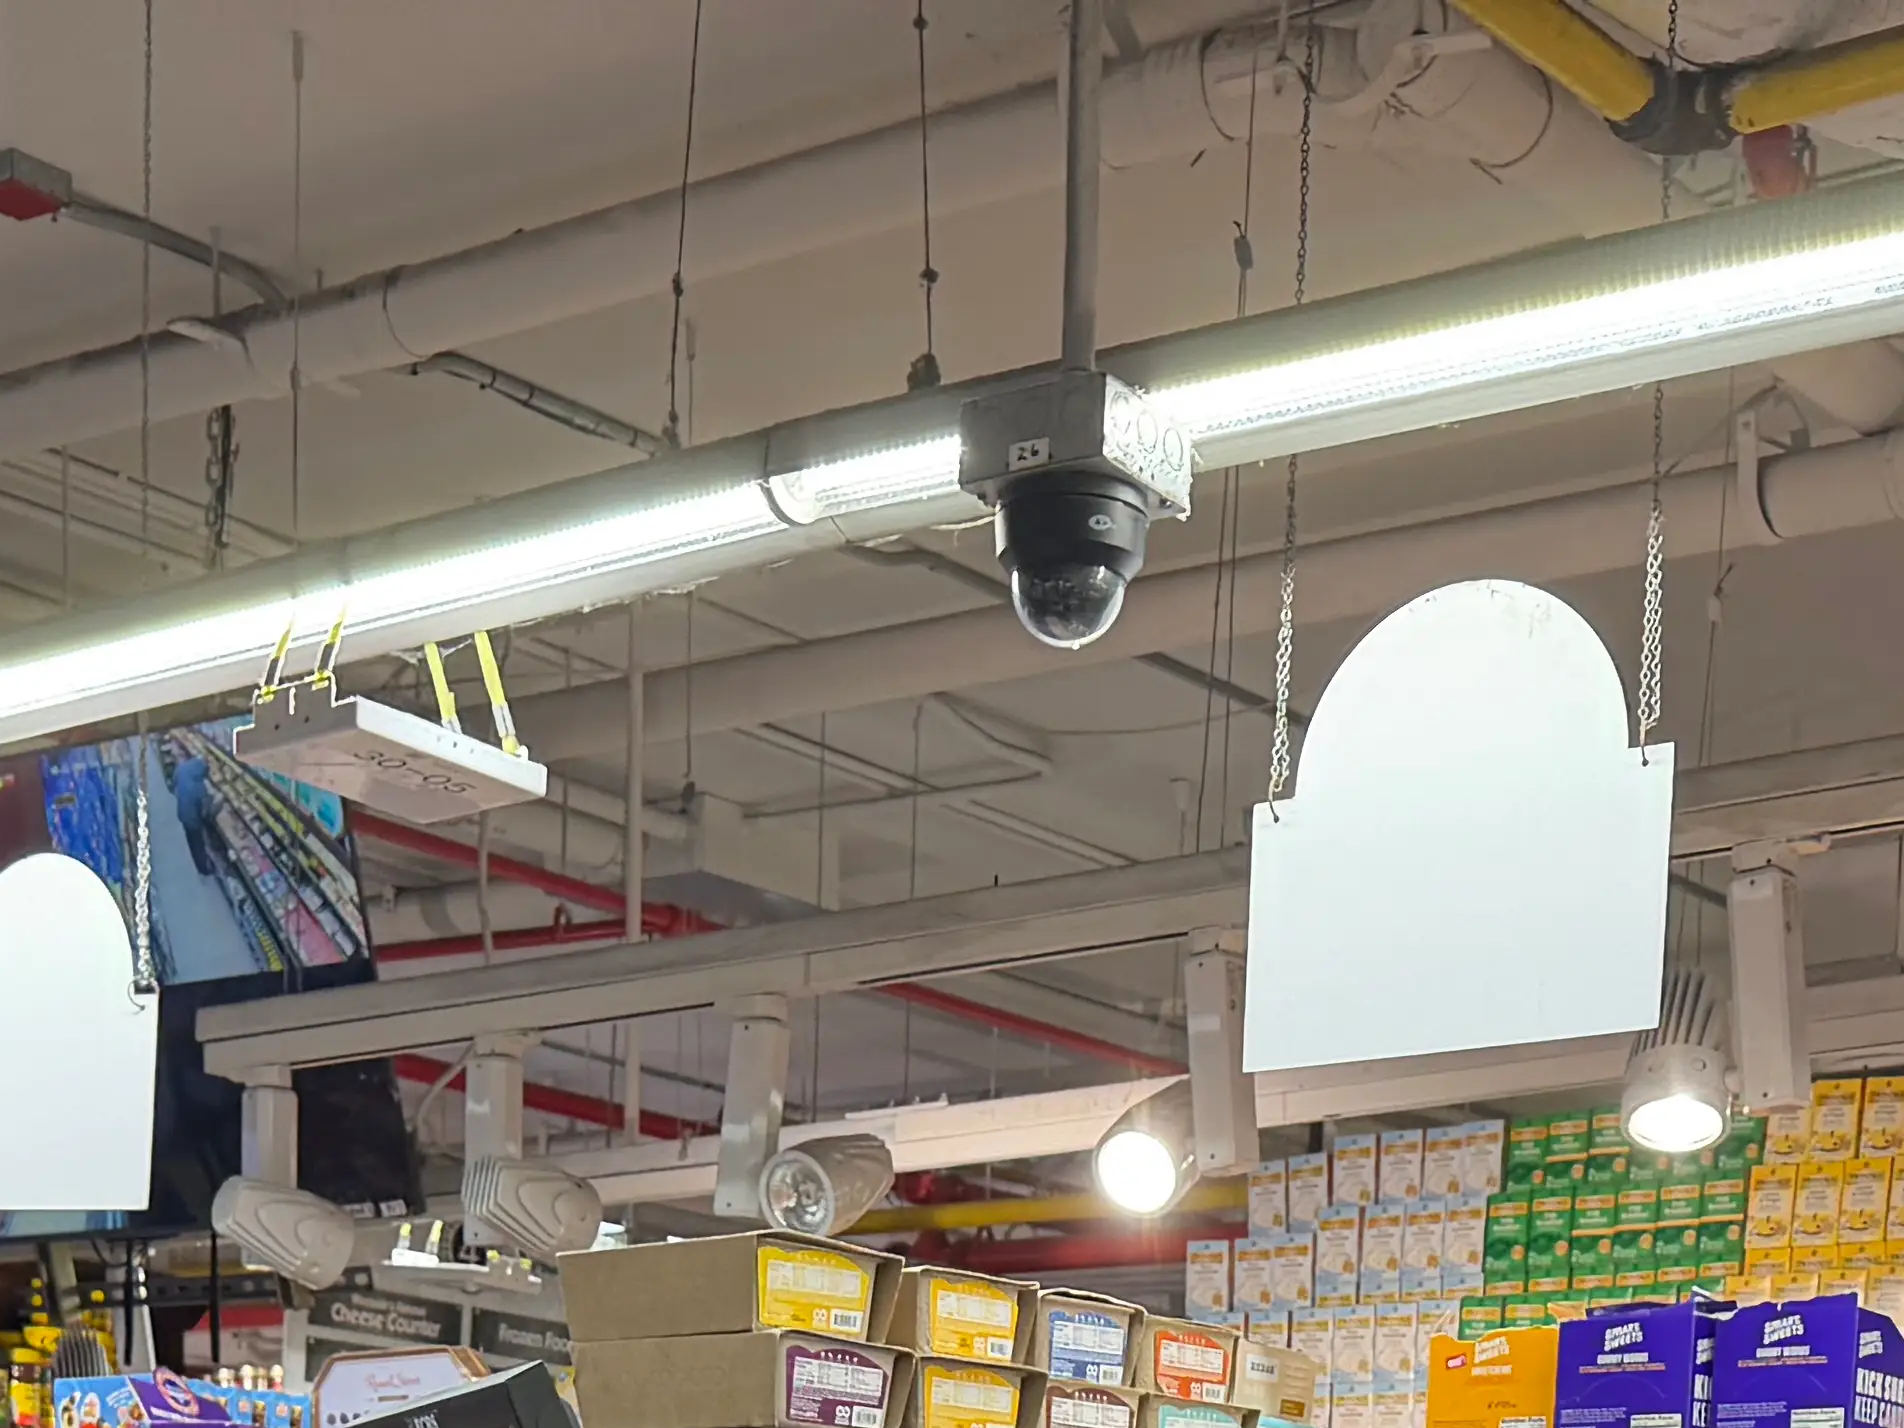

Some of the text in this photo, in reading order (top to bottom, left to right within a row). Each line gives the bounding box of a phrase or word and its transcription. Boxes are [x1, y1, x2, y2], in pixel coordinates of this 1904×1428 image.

[330, 1302, 384, 1330] Cheese
[387, 1312, 442, 1338] Counter
[1856, 1367, 1884, 1399] KICK
[1853, 1394, 1878, 1425] KEEP
